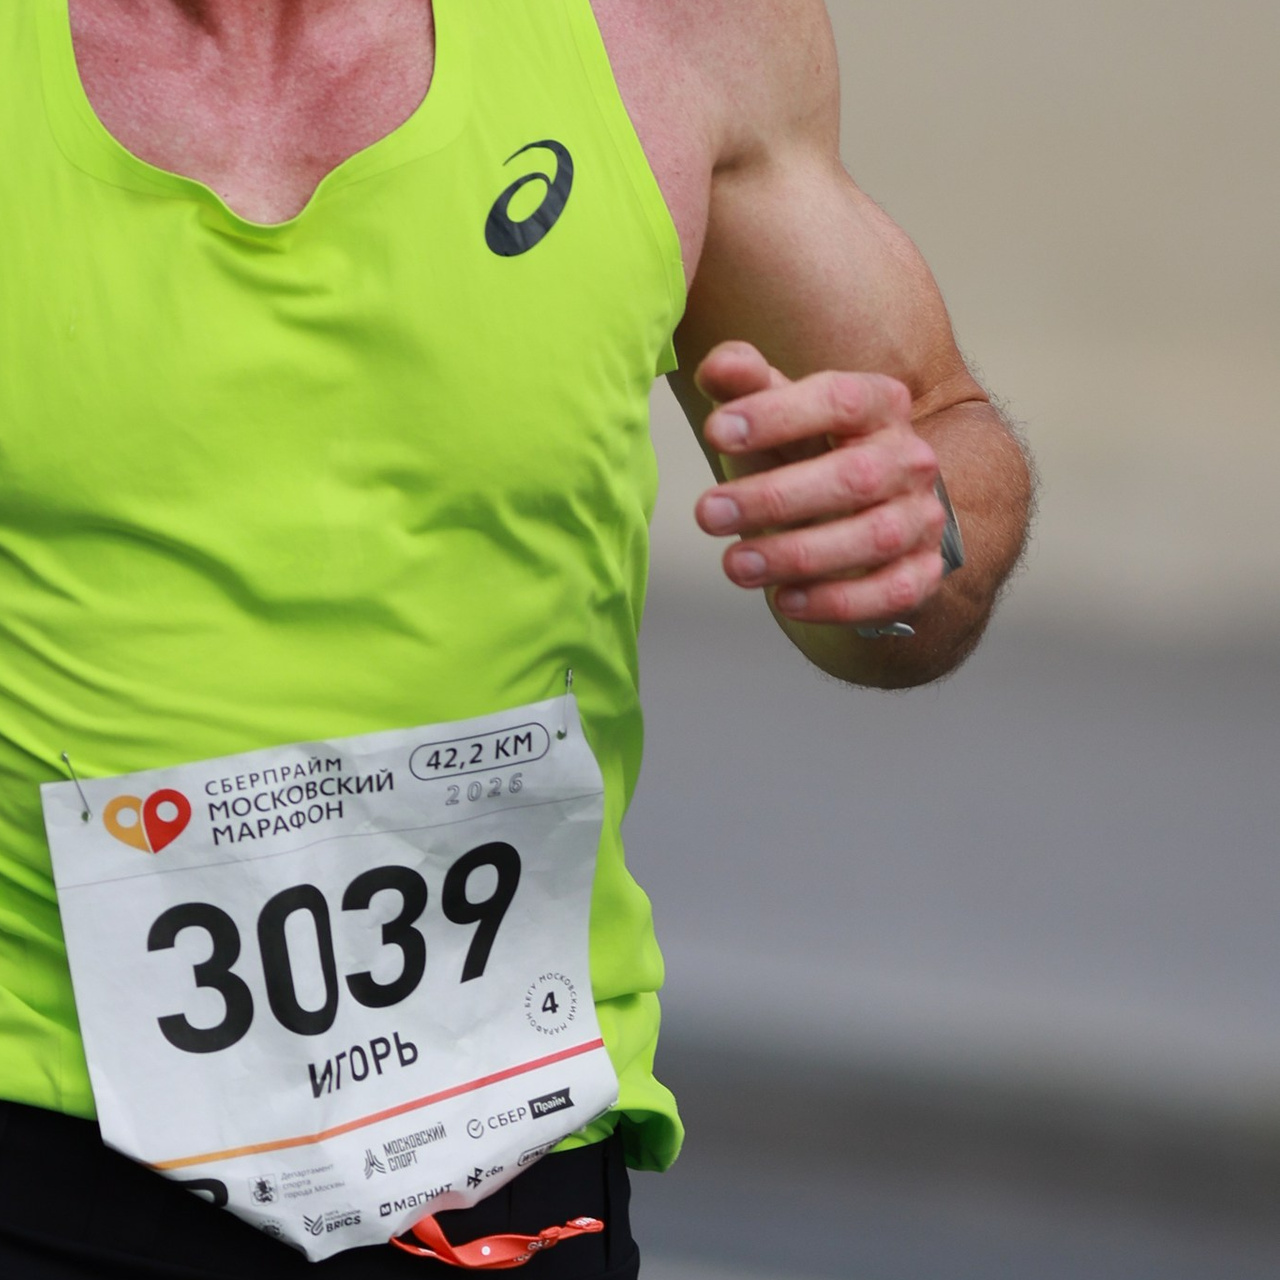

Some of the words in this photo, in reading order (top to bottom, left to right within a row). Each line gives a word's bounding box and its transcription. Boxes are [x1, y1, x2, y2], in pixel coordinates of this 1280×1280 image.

[426, 743, 483, 770] 42,2
[205, 756, 342, 796] СБЕРПРАЙМ
[445, 772, 523, 806] 2026
[208, 768, 395, 821] МОСКОВСКИЙ
[212, 800, 344, 846] МАРАФОН
[147, 841, 522, 1054] 3039
[541, 991, 559, 1014] 4
[308, 1031, 418, 1099] ИГОРЬ
[487, 1106, 527, 1130] СБЕР
[533, 1096, 567, 1114] Прайм
[382, 1121, 448, 1157] МОСКОВСКИЙ
[387, 1150, 418, 1172] СПОРТ
[325, 1215, 362, 1233] BRICS
